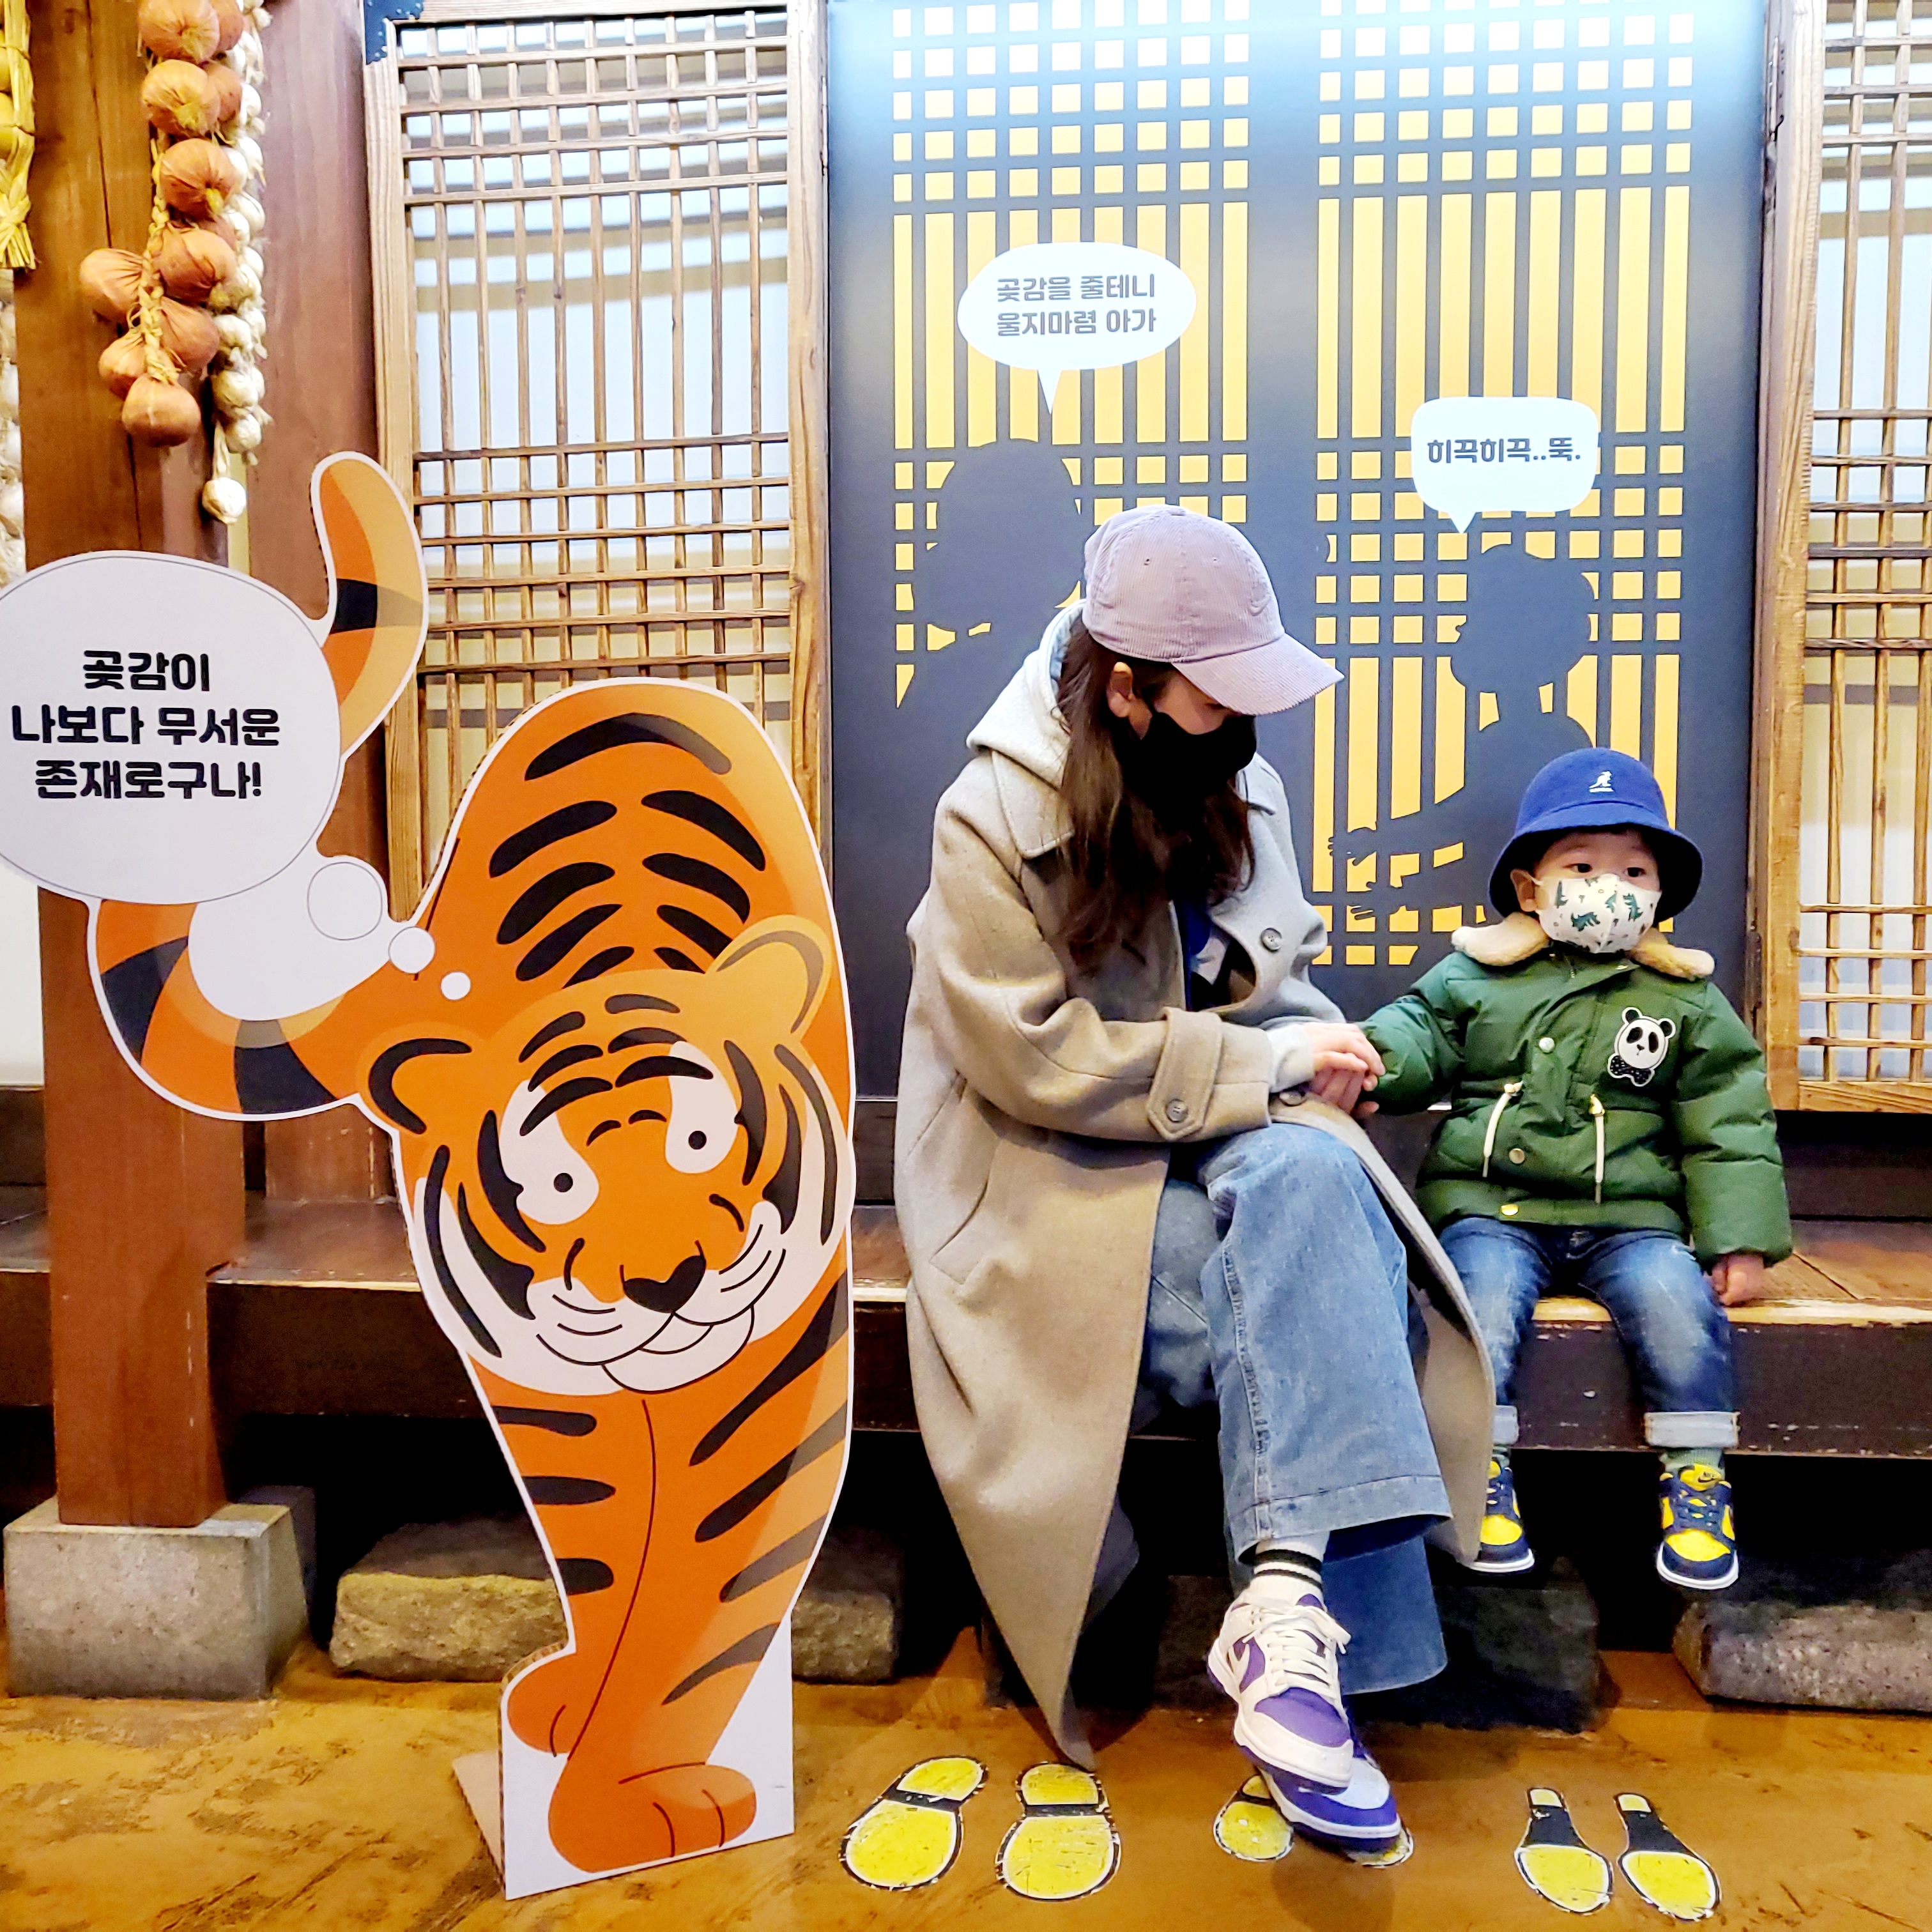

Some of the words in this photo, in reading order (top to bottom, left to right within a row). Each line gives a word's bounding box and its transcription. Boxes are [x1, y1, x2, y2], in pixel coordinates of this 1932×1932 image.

[997, 276, 1071, 302] 곶감을
[1080, 273, 1154, 300] 줄테니
[997, 310, 1097, 337] 울지마렴
[1105, 308, 1156, 333] 아가
[82, 650, 210, 692] 곶감이
[12, 703, 144, 745] 나보다
[157, 707, 280, 746] 무서운
[34, 760, 261, 799] 존재로구나!
